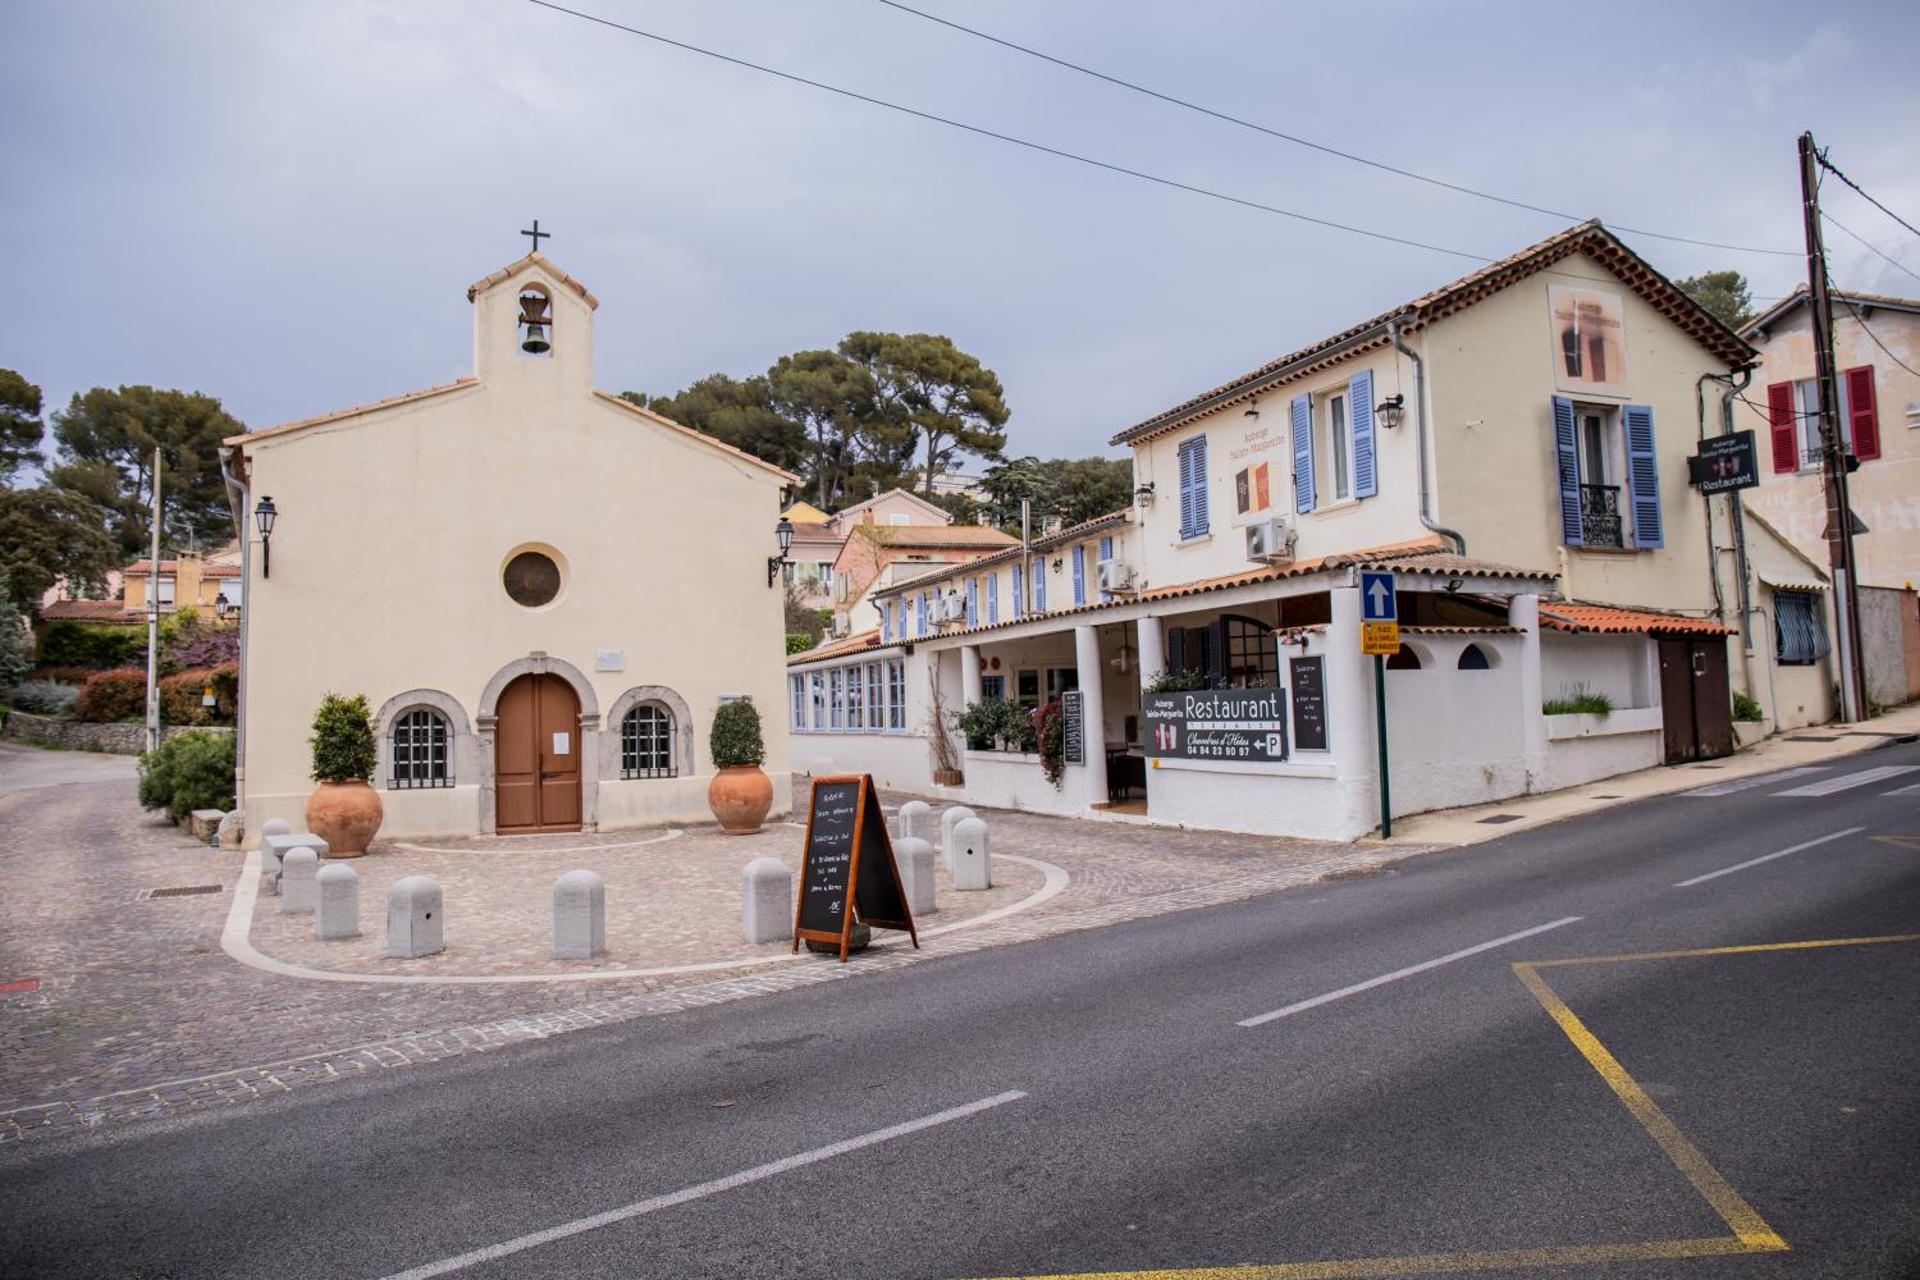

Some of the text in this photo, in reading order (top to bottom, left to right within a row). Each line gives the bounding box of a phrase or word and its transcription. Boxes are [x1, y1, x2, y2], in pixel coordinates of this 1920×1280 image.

[1703, 473, 1752, 491] Restaurant
[1185, 693, 1279, 719] Restaurant
[1188, 746, 1197, 754] 04
